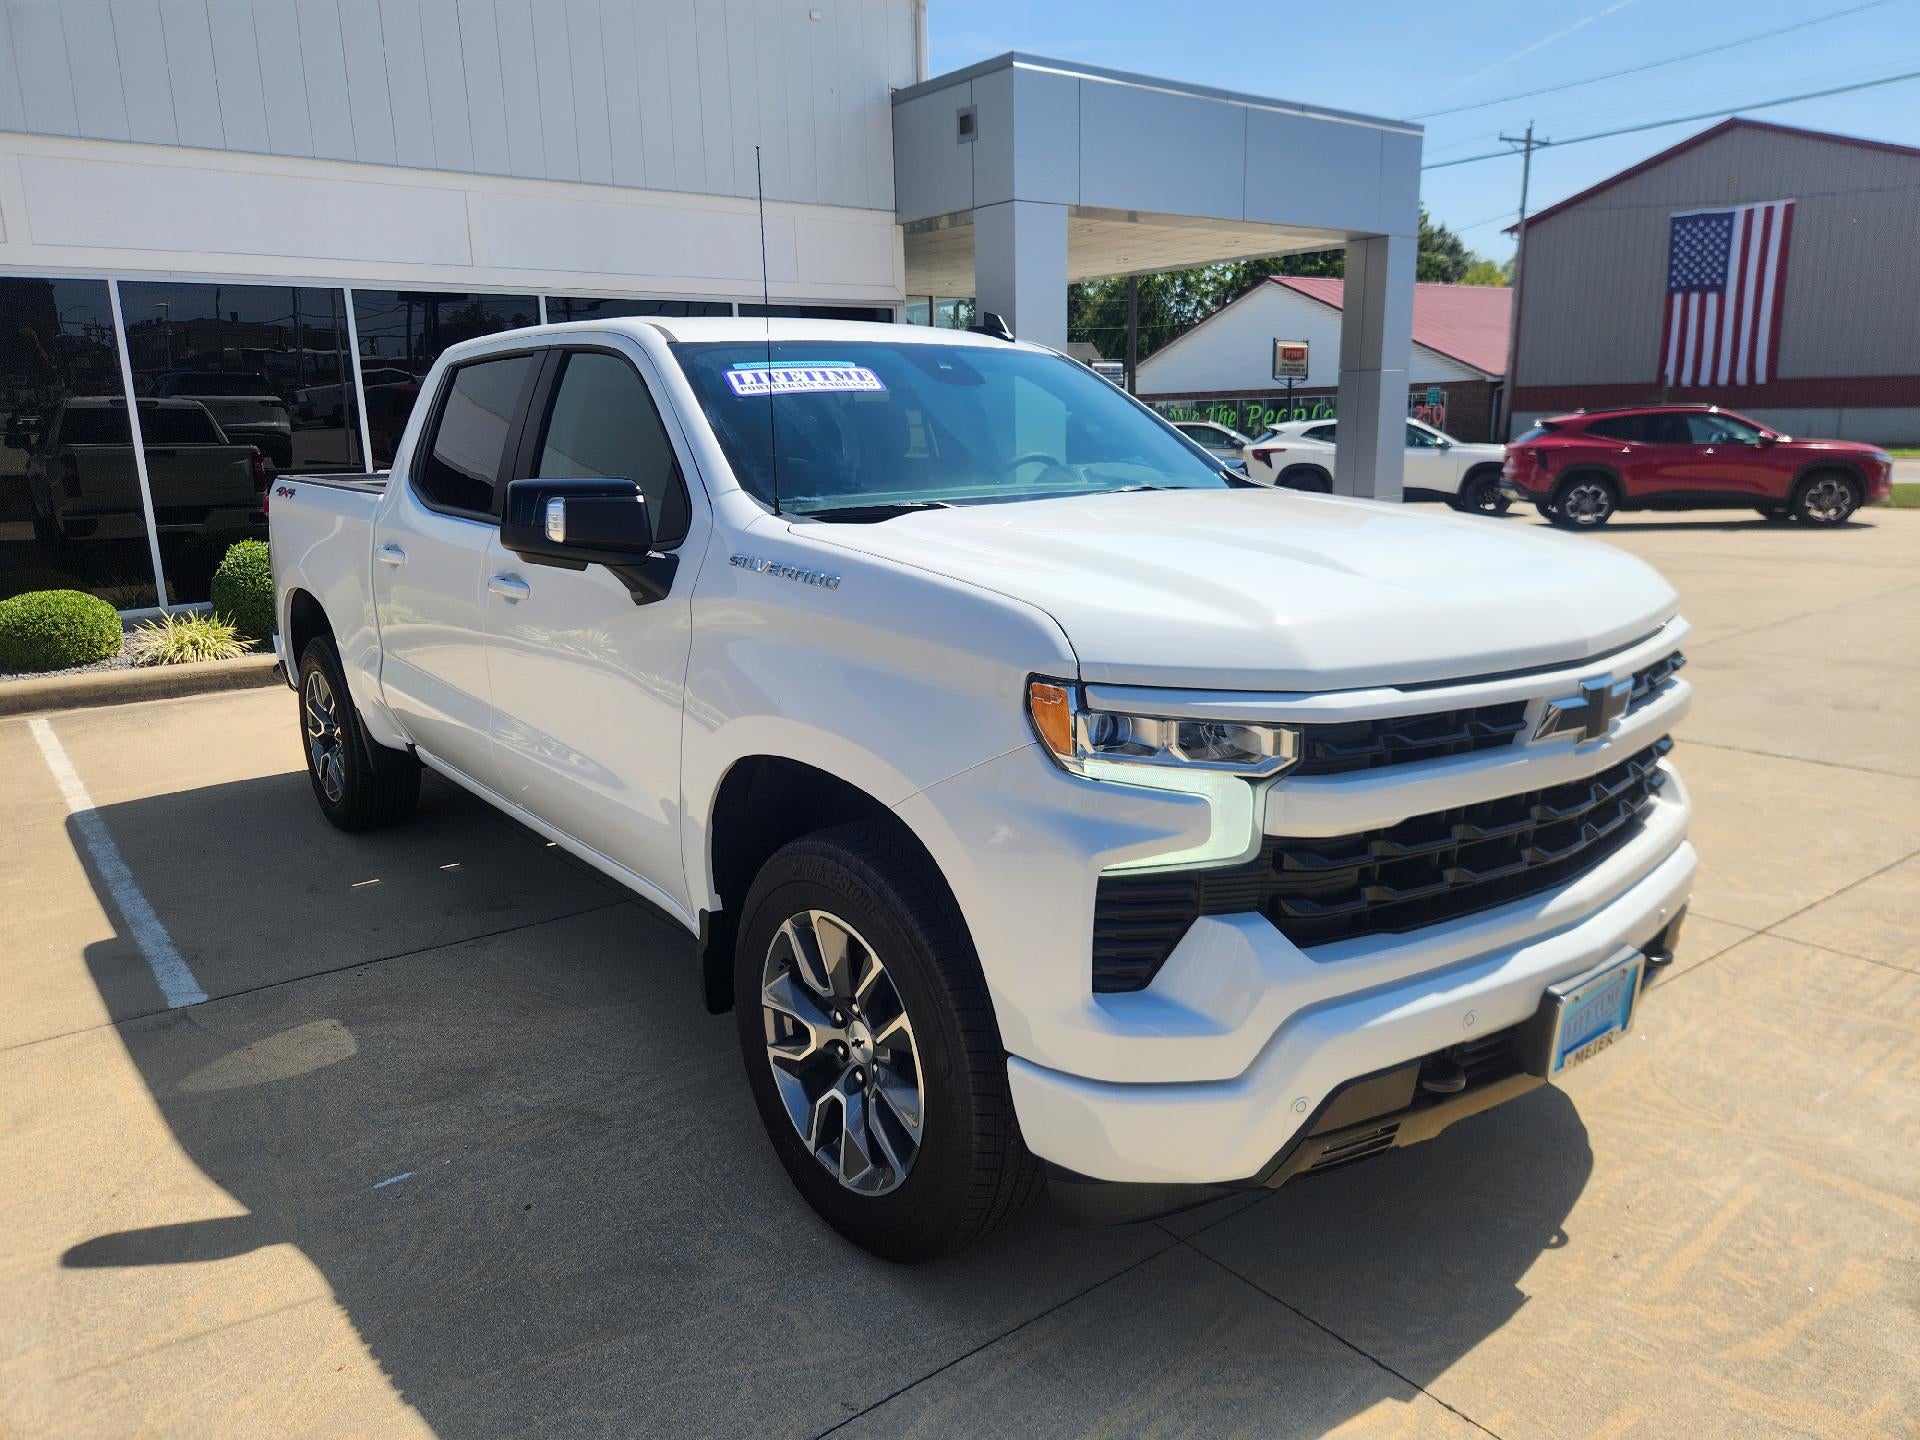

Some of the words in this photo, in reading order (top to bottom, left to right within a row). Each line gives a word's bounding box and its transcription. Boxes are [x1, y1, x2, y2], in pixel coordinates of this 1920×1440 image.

[733, 370, 874, 385] LIFETIME
[740, 382, 816, 392] POWERTRAIN
[818, 380, 877, 389] WARRANTY
[728, 554, 841, 591] SILVERADO
[1574, 1035, 1613, 1066] MEIER
